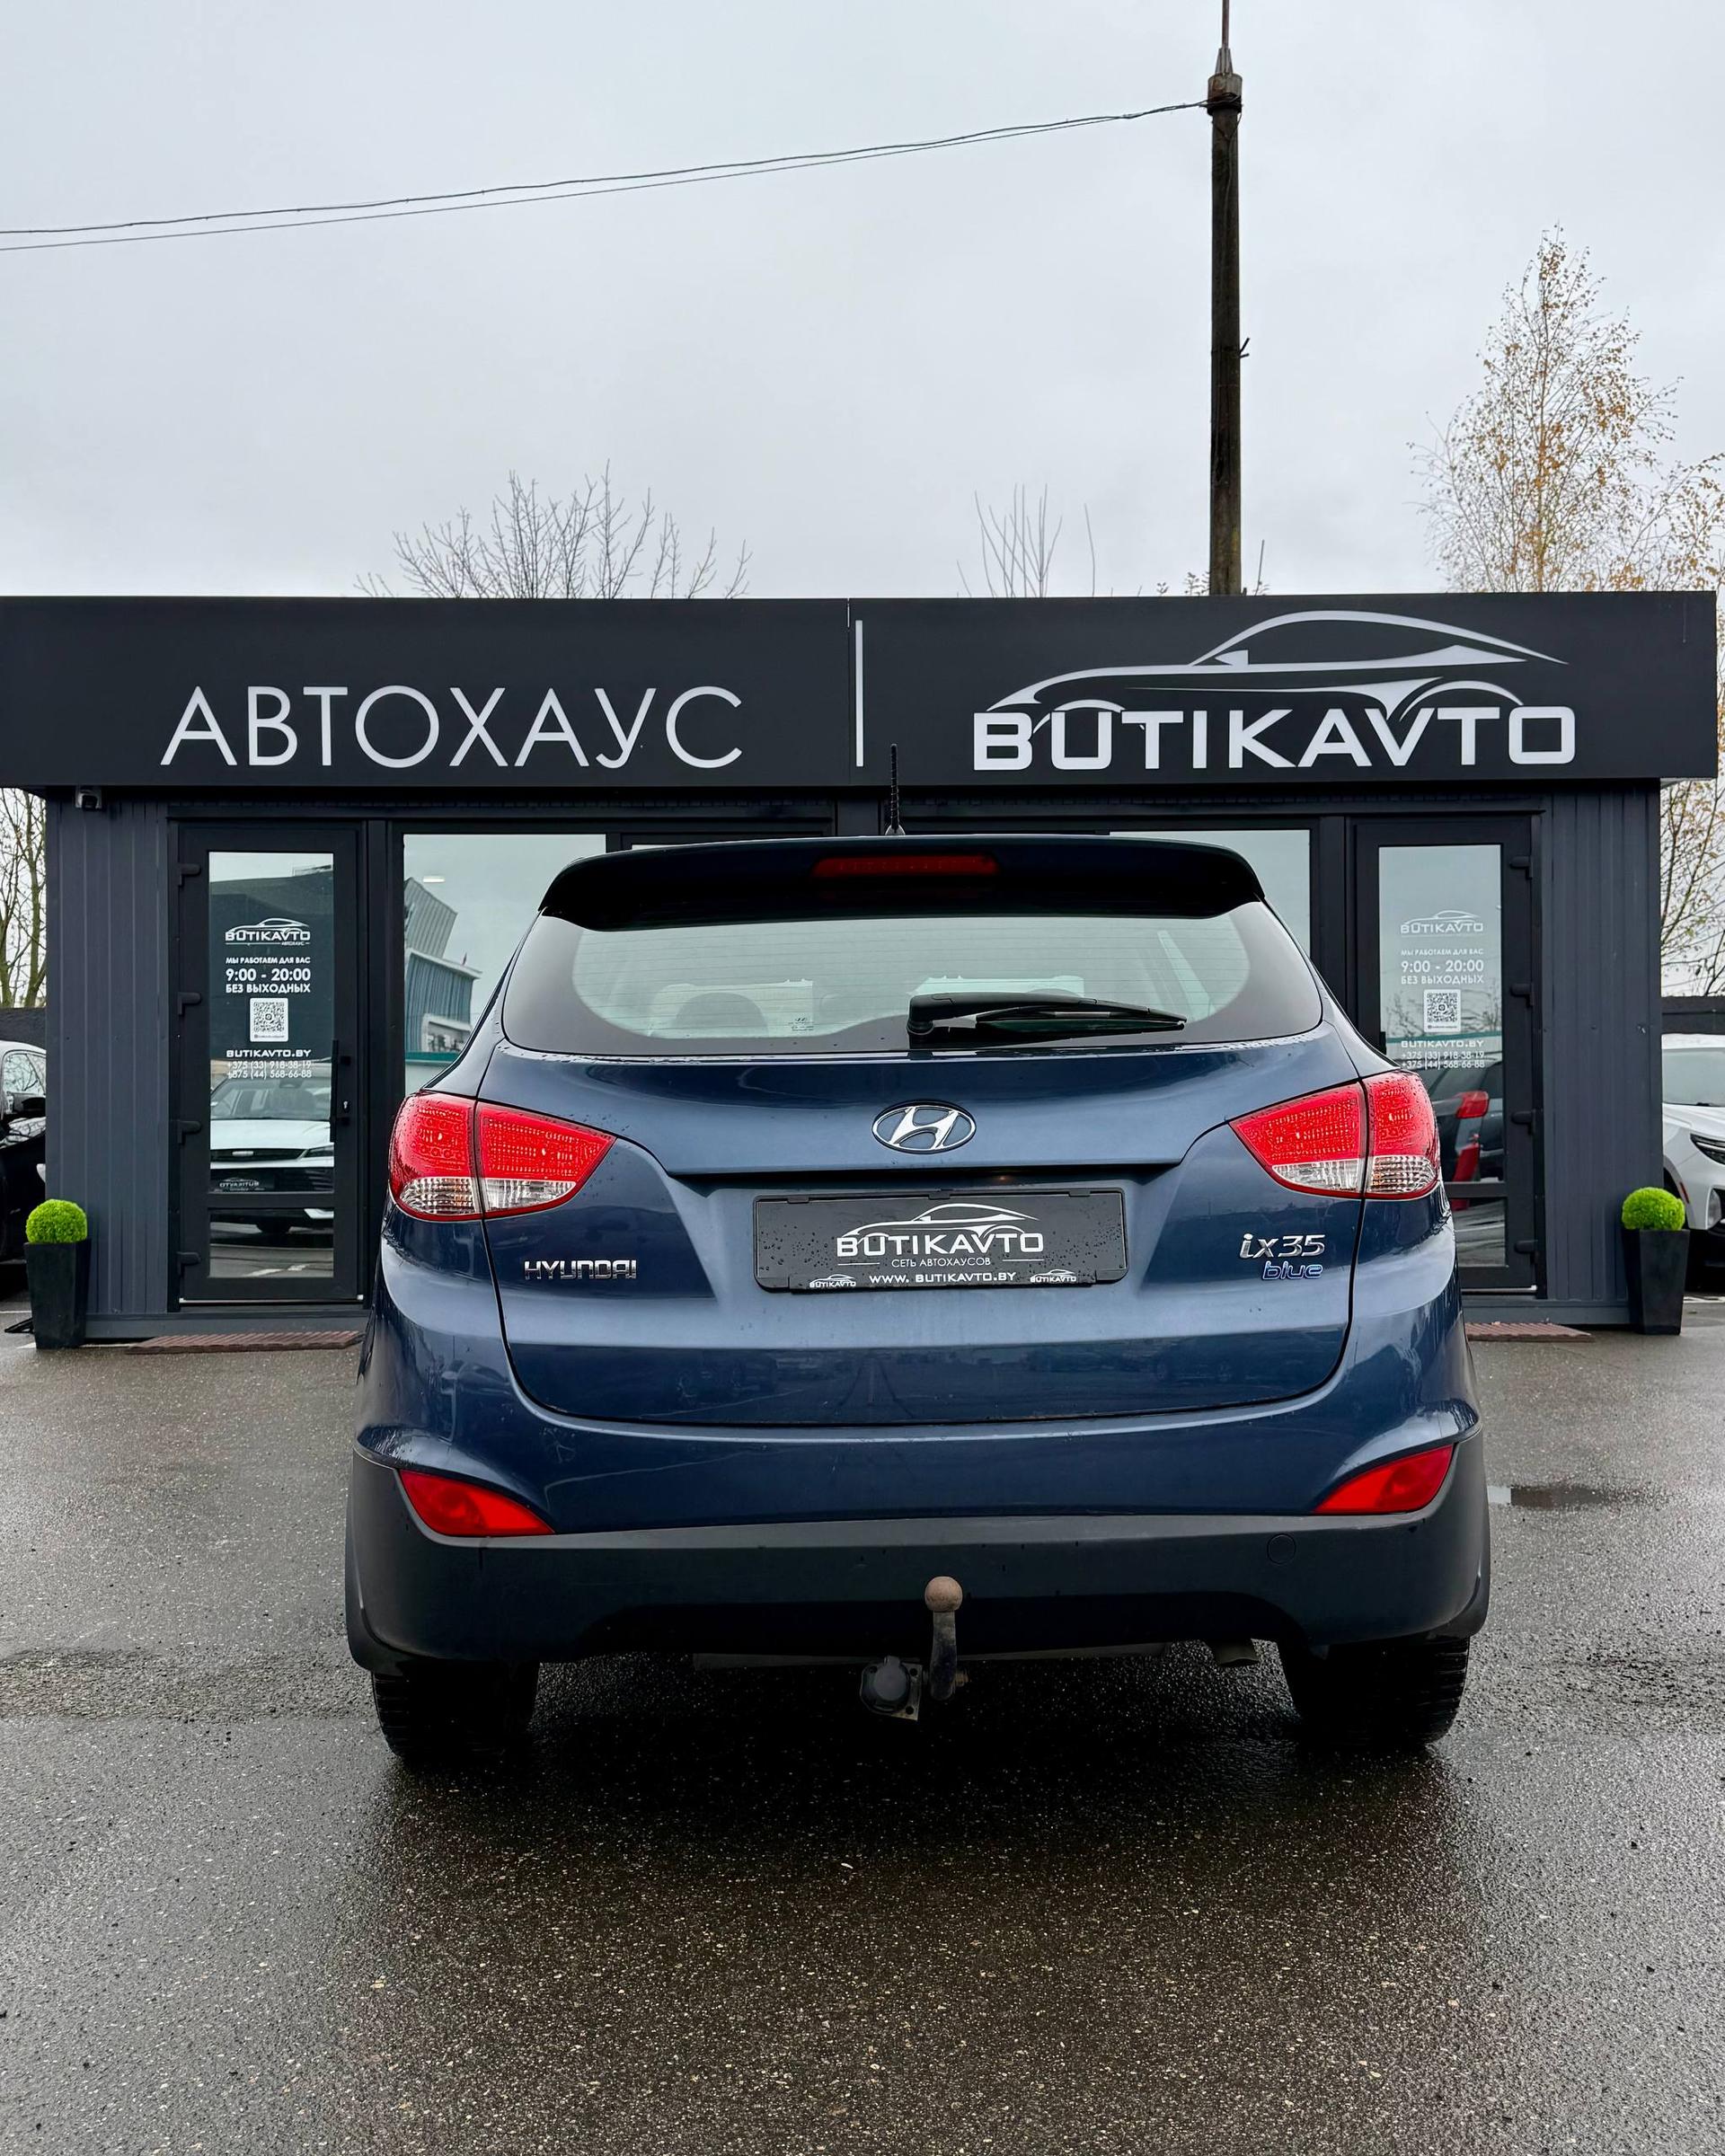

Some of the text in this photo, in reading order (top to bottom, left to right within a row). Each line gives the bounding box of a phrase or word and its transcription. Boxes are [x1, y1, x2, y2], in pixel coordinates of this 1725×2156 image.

[161, 685, 743, 769] АВТОХАУС
[973, 705, 1576, 771] BUTIKAVTO
[1401, 923, 1483, 933] BUTIKAVTO
[225, 931, 311, 941] BUTIKAVTO
[1401, 960, 1430, 973] 9:00
[1445, 959, 1484, 972] 20:00
[226, 968, 256, 981] 9:00
[270, 968, 311, 981] 20:00
[1401, 975, 1484, 985] БЕЗ ВЫХОДНЫХ
[226, 983, 311, 994] БЕЗ ВЫХОДНЫХ
[1401, 1040, 1484, 1048] BUTIKAVTO.BY
[226, 1049, 312, 1057] BUTIKAVTO.BY
[836, 1232, 1044, 1258] BUTIKAVTO
[1239, 1233, 1326, 1259] ix35
[891, 1257, 991, 1268] СЕТЬ АВТОХАУСОВ
[524, 1259, 637, 1279] HYUNDAI
[1262, 1260, 1323, 1280] blue
[915, 1272, 1017, 1283] BUTIKAVTO.BY
